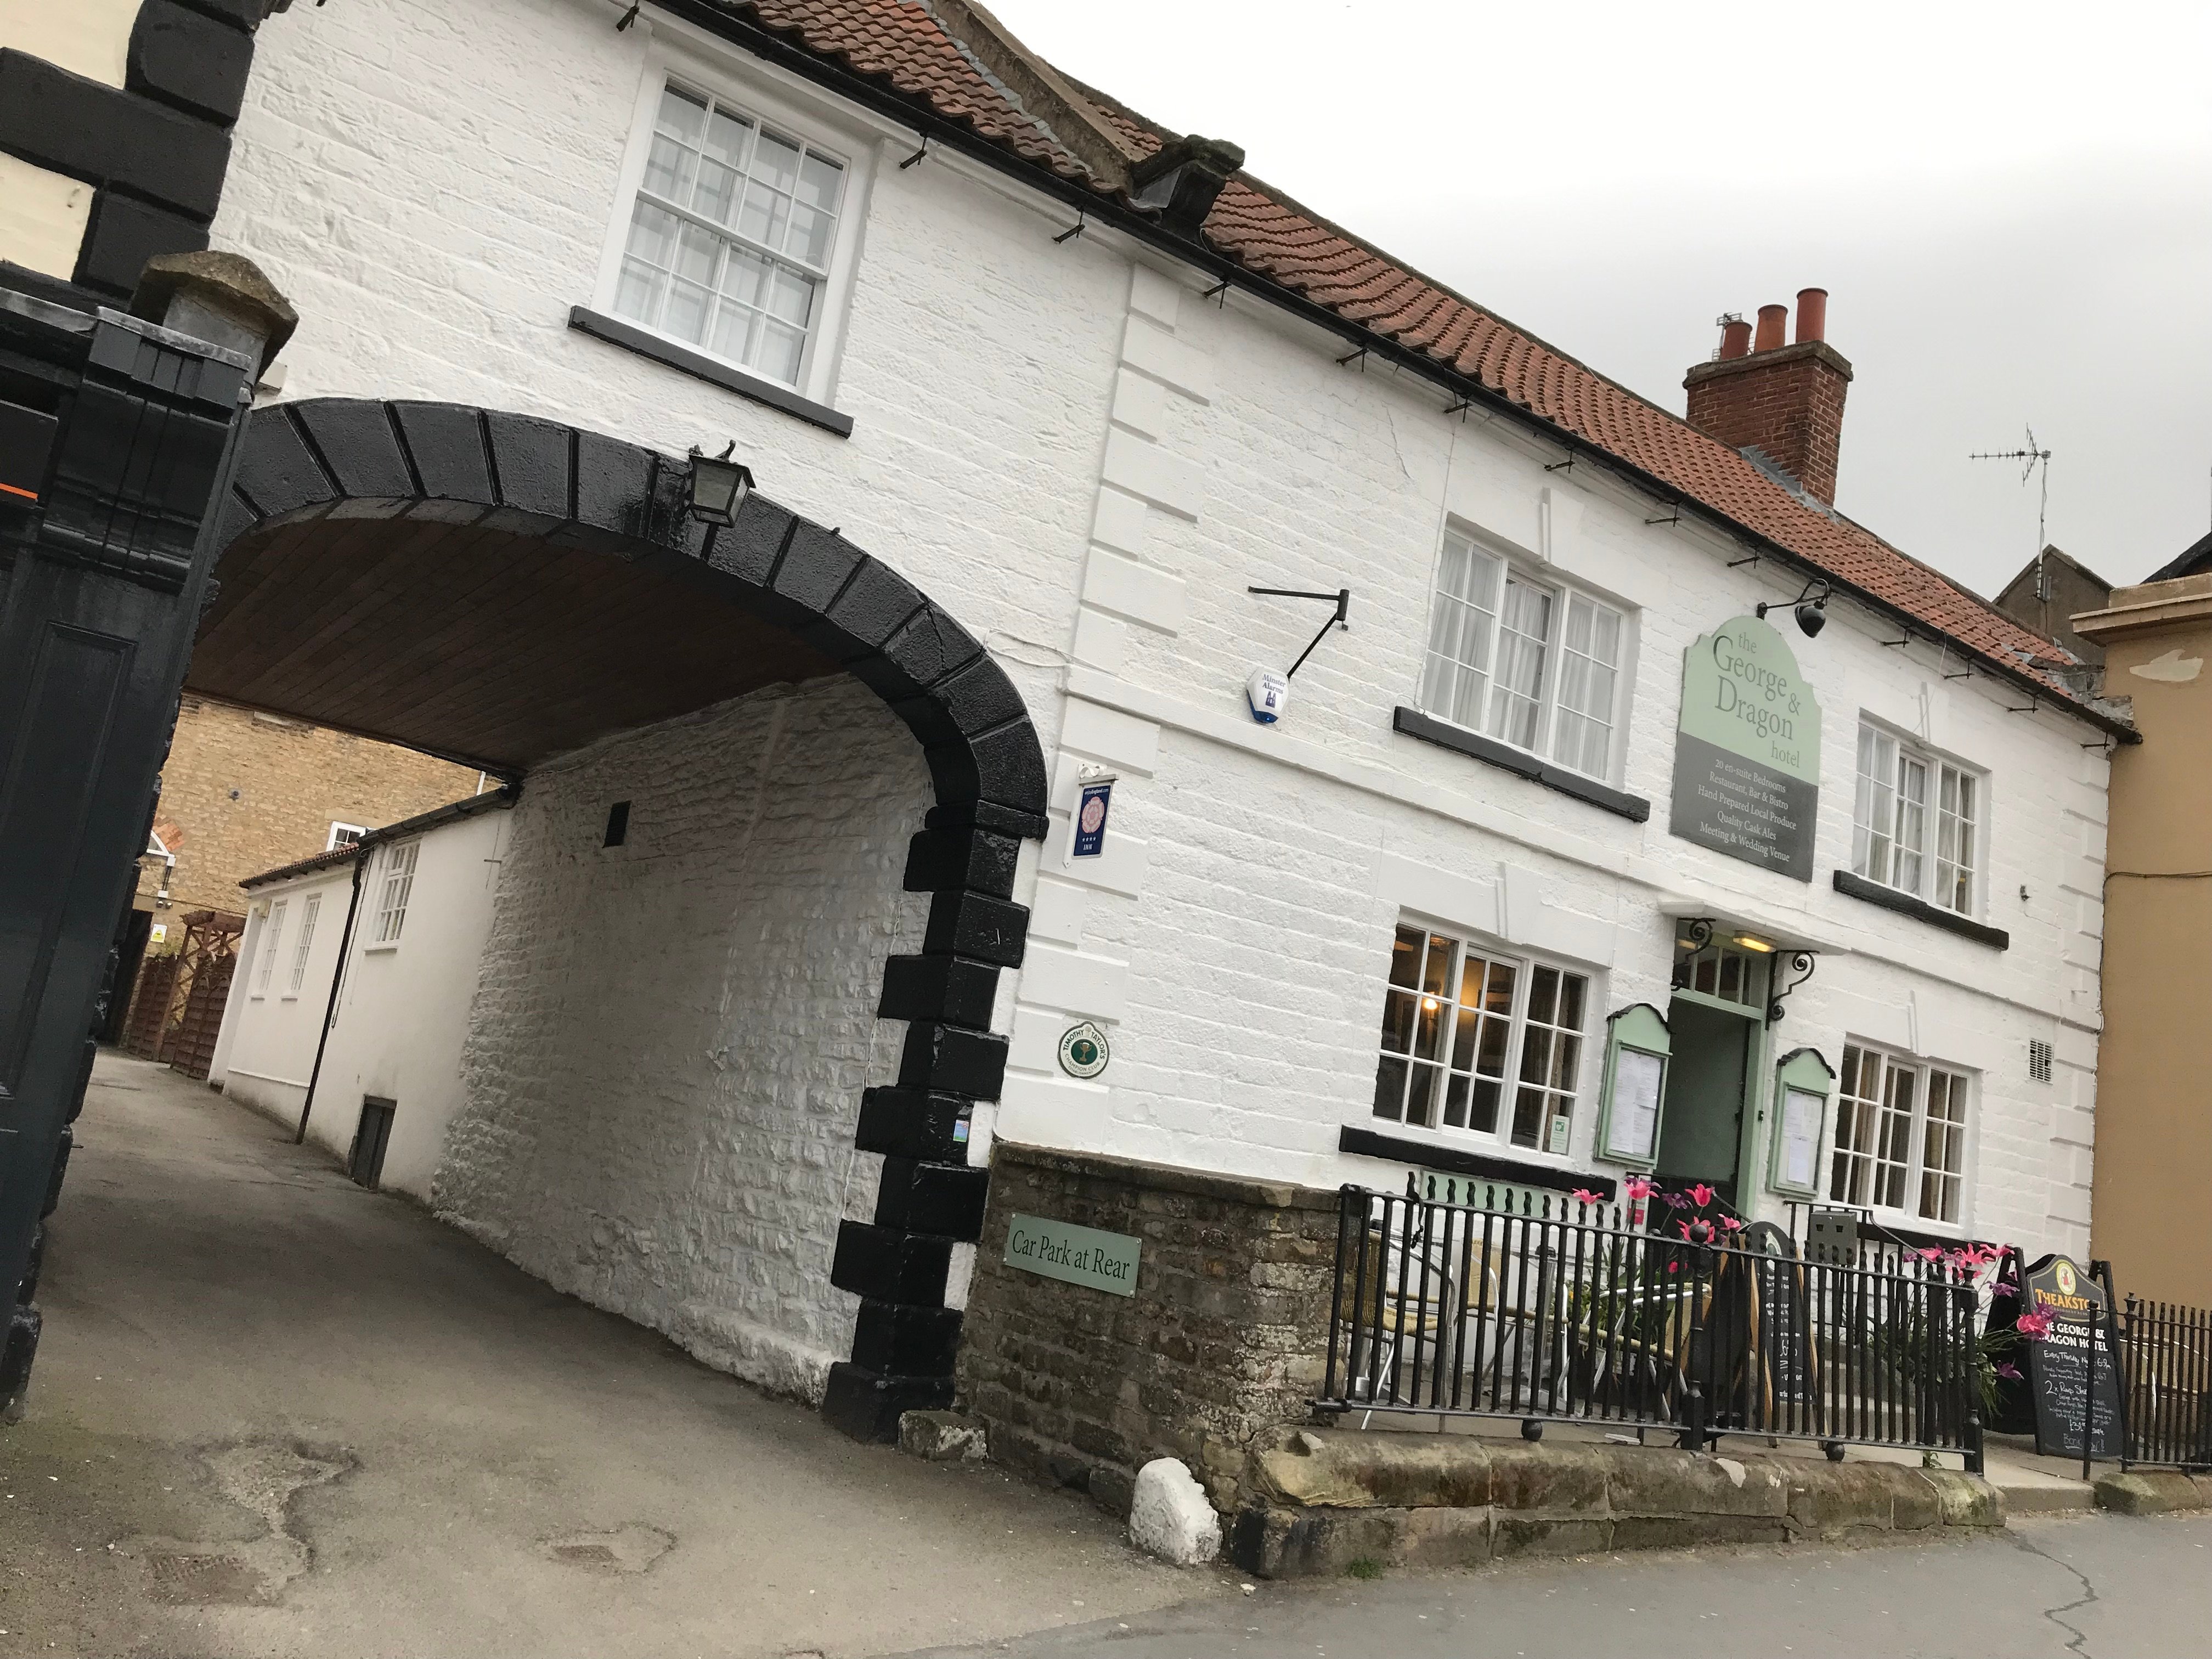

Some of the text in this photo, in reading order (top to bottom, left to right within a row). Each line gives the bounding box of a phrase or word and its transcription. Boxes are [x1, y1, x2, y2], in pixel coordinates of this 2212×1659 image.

[1739, 631, 1757, 653] the
[1262, 674, 1286, 687] Minster
[1262, 682, 1284, 695] Alarms
[1713, 635, 1801, 716] George &
[1714, 675, 1793, 741] Dragon
[1771, 741, 1800, 768] hotel
[1709, 771, 1788, 810] Restaurant, Bar & Bistro
[1715, 759, 1786, 793] 20 en-suite Bedrooms
[1698, 784, 1797, 830] Hand Prepared Local Produce
[1717, 810, 1776, 840] Quality Cask Ales
[1700, 821, 1790, 862] Meeting & Wedding Venue
[1063, 1029, 1106, 1059] TIMOTHY TAYLOR'S
[1065, 1053, 1101, 1071] CHAMPION CLUB
[1012, 1230, 1130, 1279] Car Park at Rear
[2039, 1334, 2077, 1347] RAGON
